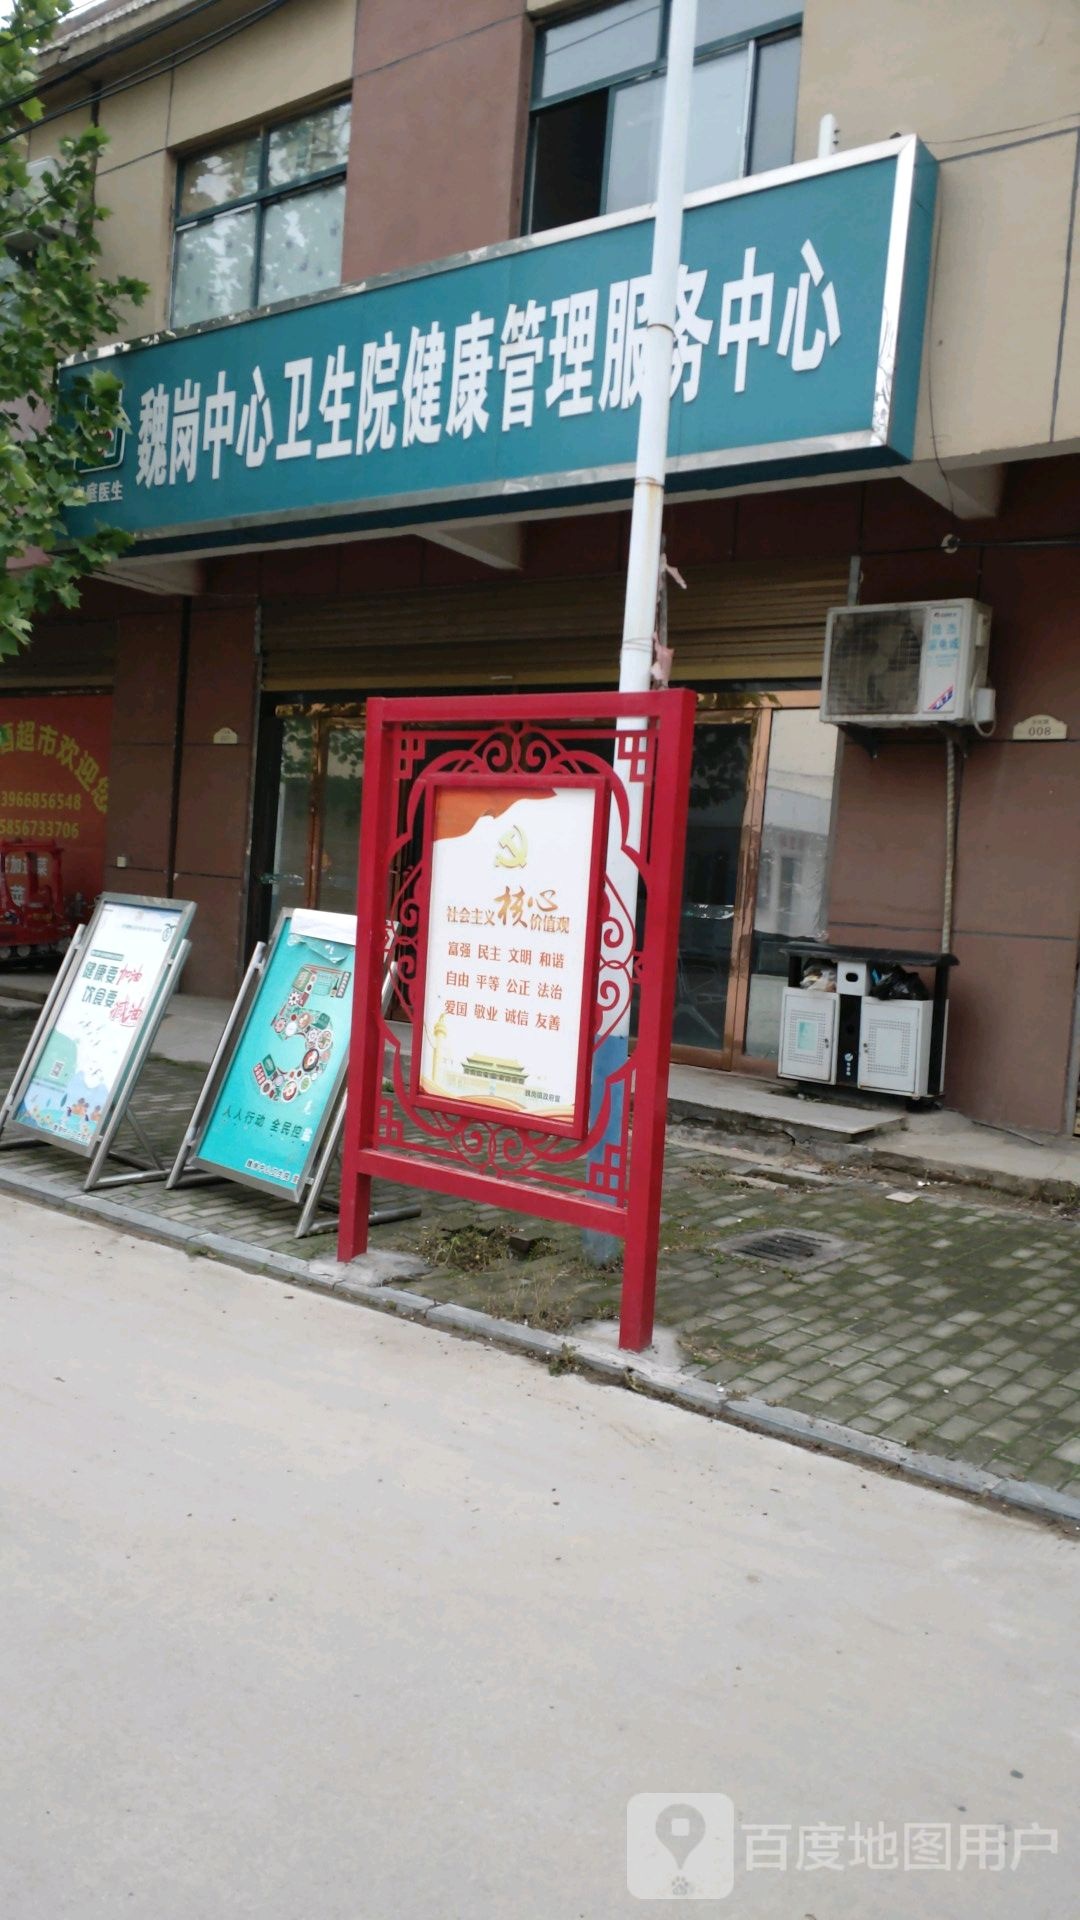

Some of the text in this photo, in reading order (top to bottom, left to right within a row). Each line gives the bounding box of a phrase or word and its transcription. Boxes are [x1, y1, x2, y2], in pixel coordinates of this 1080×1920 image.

[73, 480, 123, 503] 庭医生
[1029, 727, 1051, 736] 008
[448, 942, 564, 969] 富强 民主 文明 和谐
[446, 971, 563, 1001] 自由 平等 公正 法治
[444, 1000, 561, 1031] 爱国 敬业 诚信 友善
[223, 1105, 265, 1127] 人人行动
